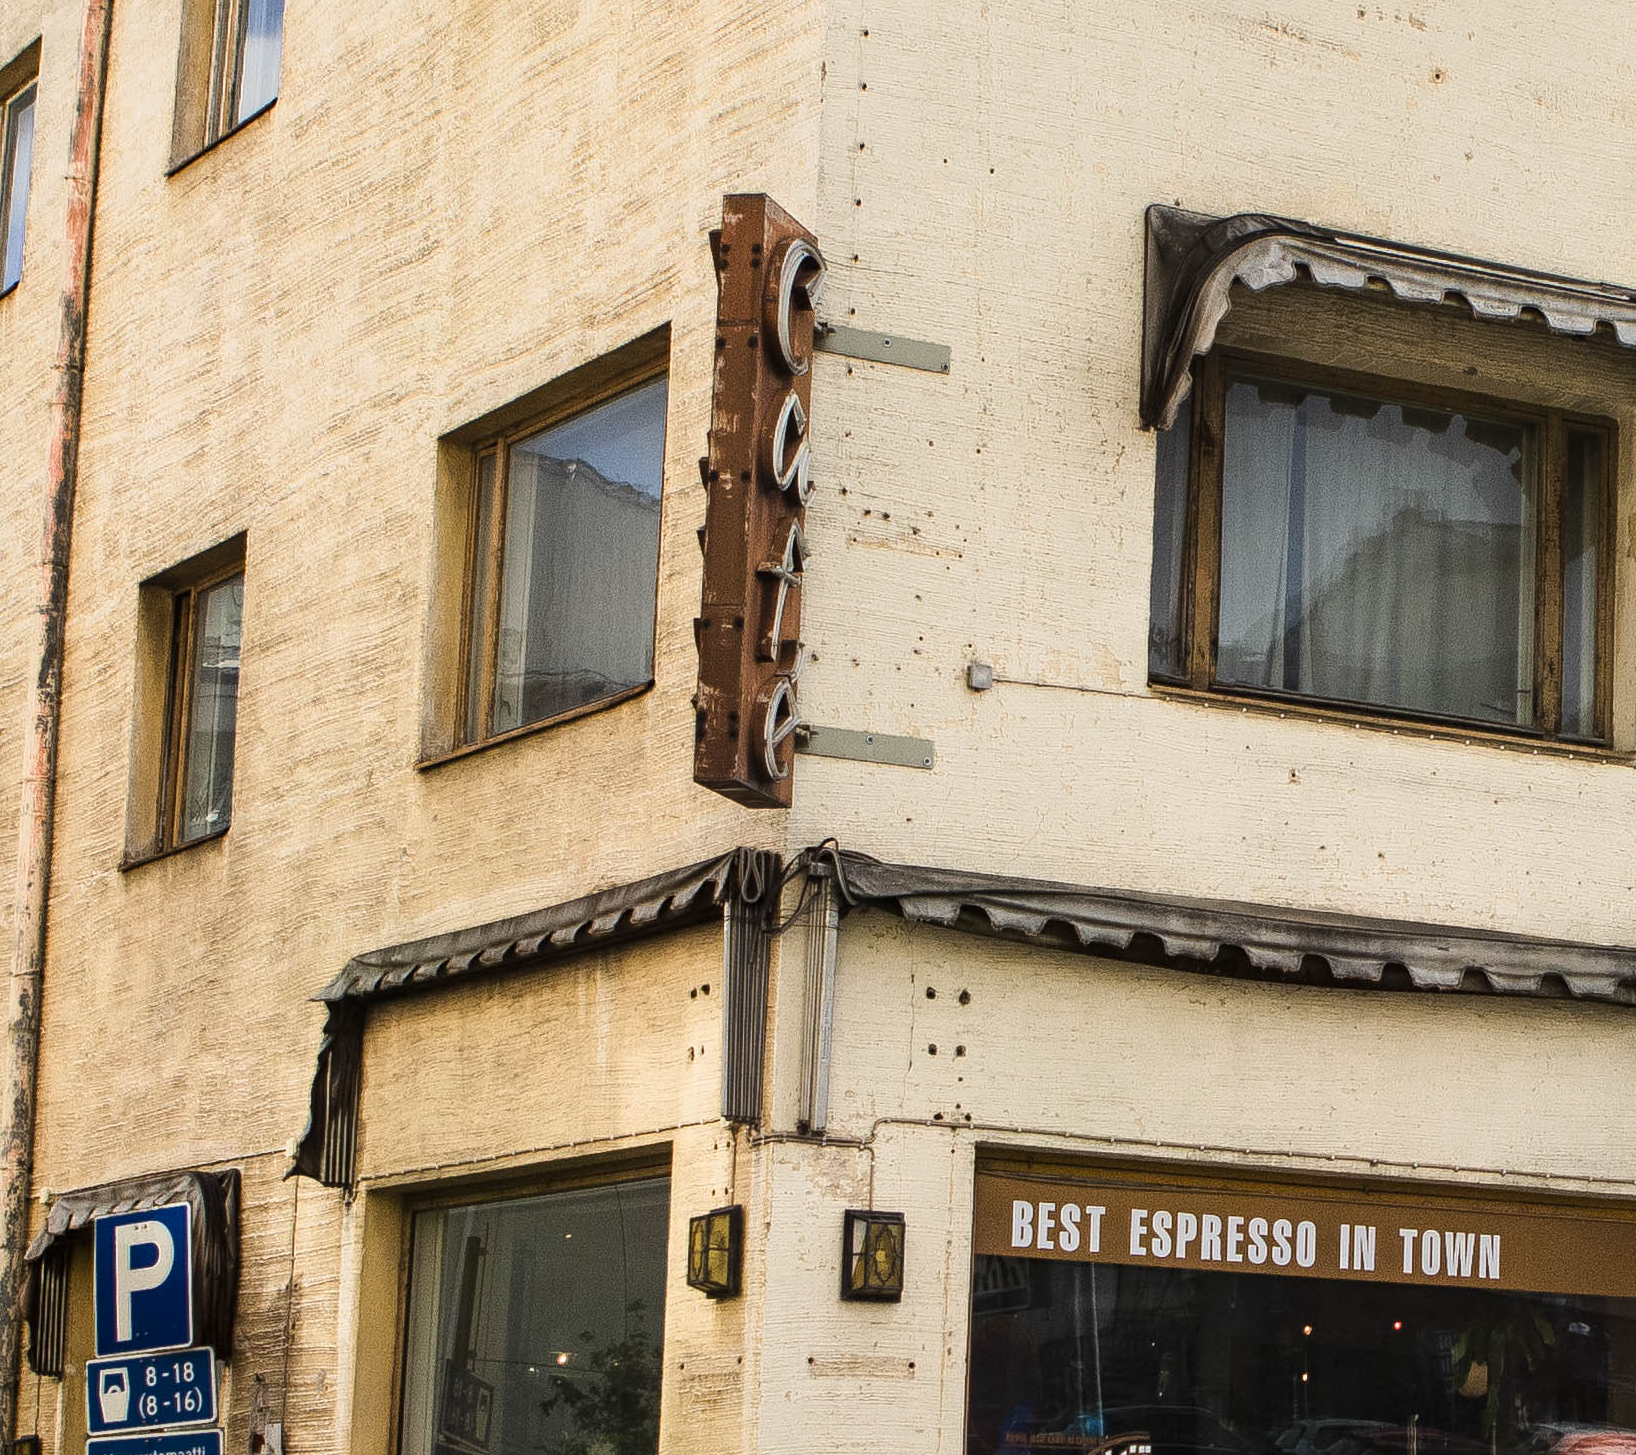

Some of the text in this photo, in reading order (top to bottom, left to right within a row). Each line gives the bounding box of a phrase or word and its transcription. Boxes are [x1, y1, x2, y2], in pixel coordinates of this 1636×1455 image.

[114, 1220, 174, 1342] P
[1011, 1200, 1501, 1279] BEST ESPRESSO IN TOWN
